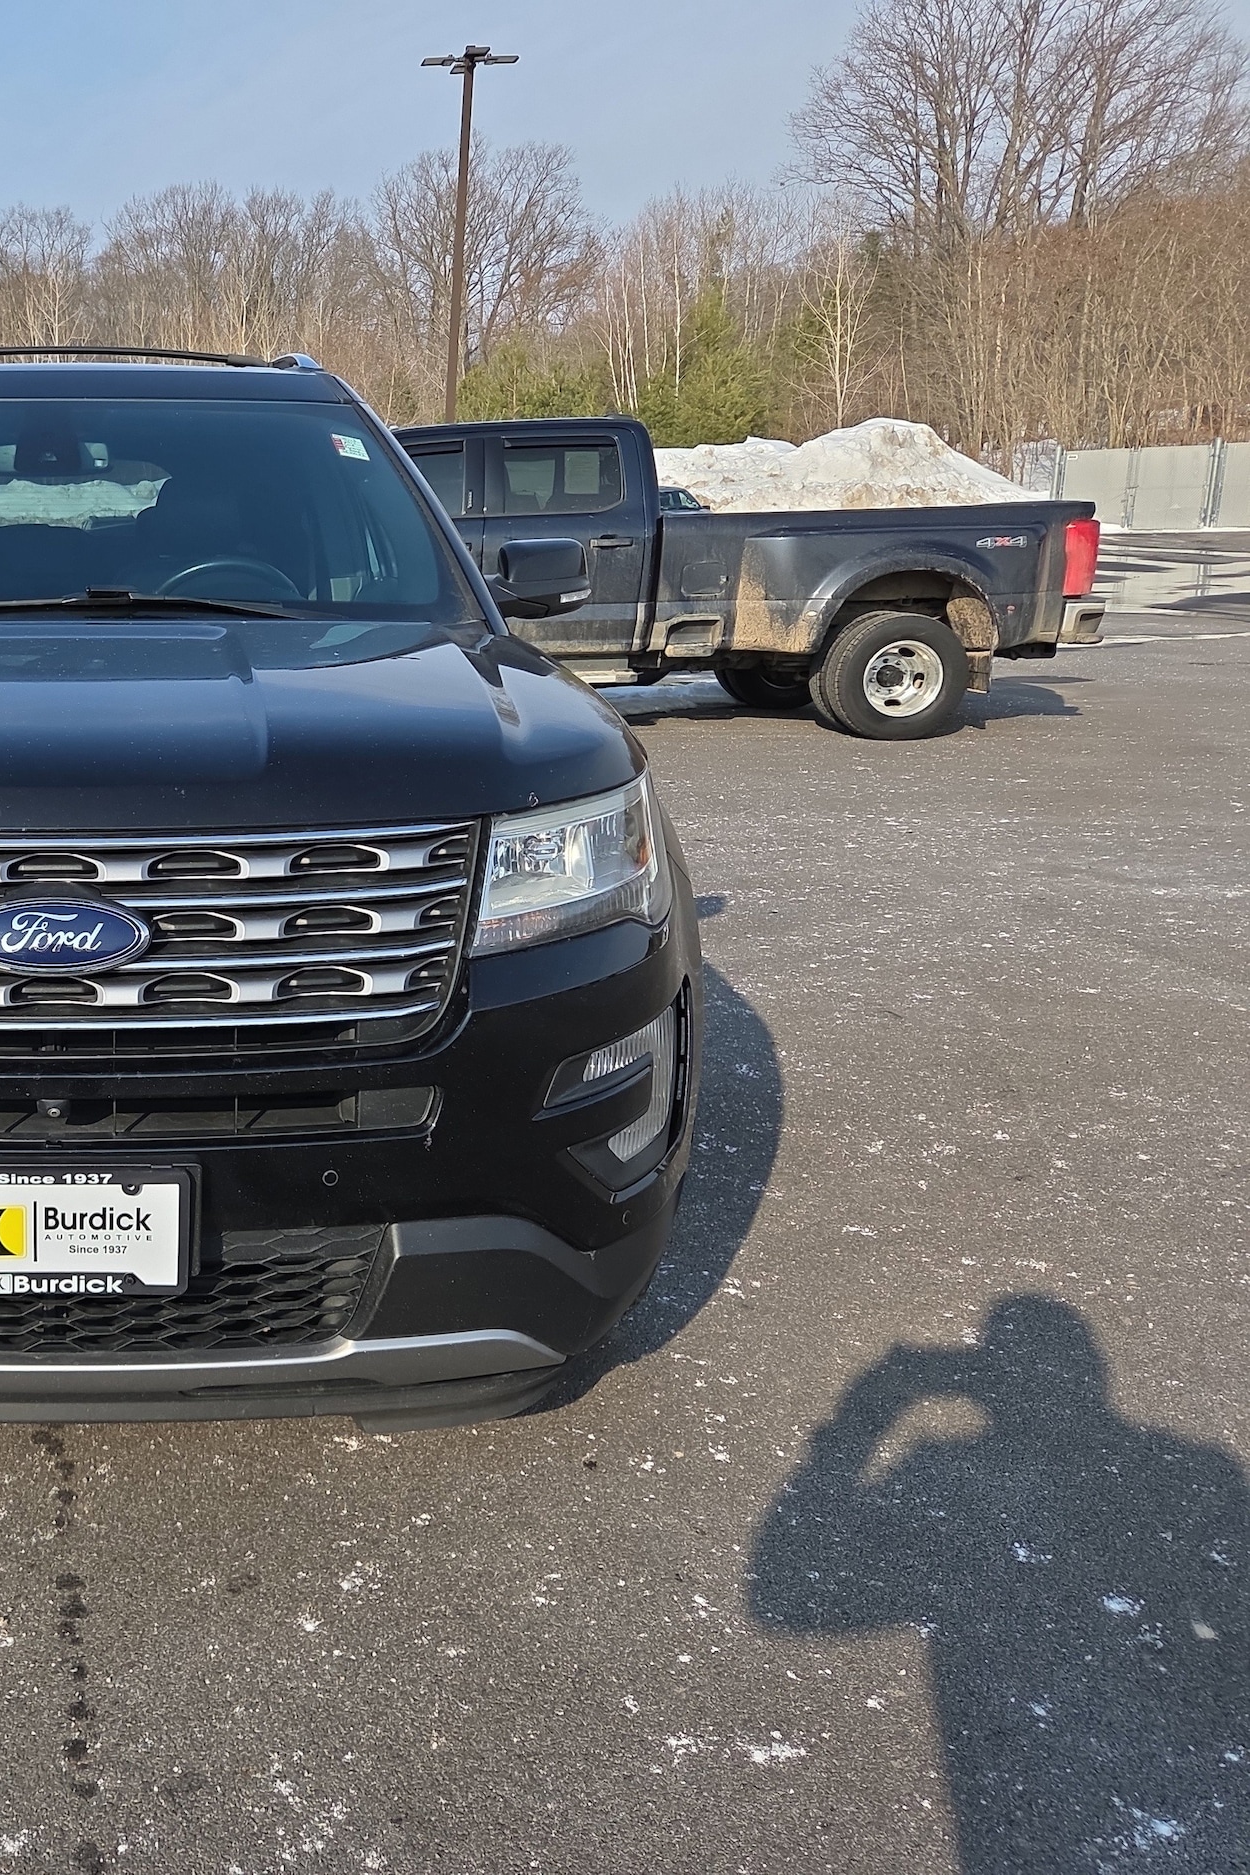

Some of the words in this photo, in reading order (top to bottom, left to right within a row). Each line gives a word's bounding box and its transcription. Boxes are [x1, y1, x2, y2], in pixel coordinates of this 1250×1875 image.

[1, 911, 104, 953] Ford
[62, 1173, 112, 1184] 1937
[44, 1207, 152, 1231] Burdick
[69, 1245, 99, 1254] Since
[103, 1245, 128, 1254] 1937
[13, 1275, 124, 1293] Burdick
